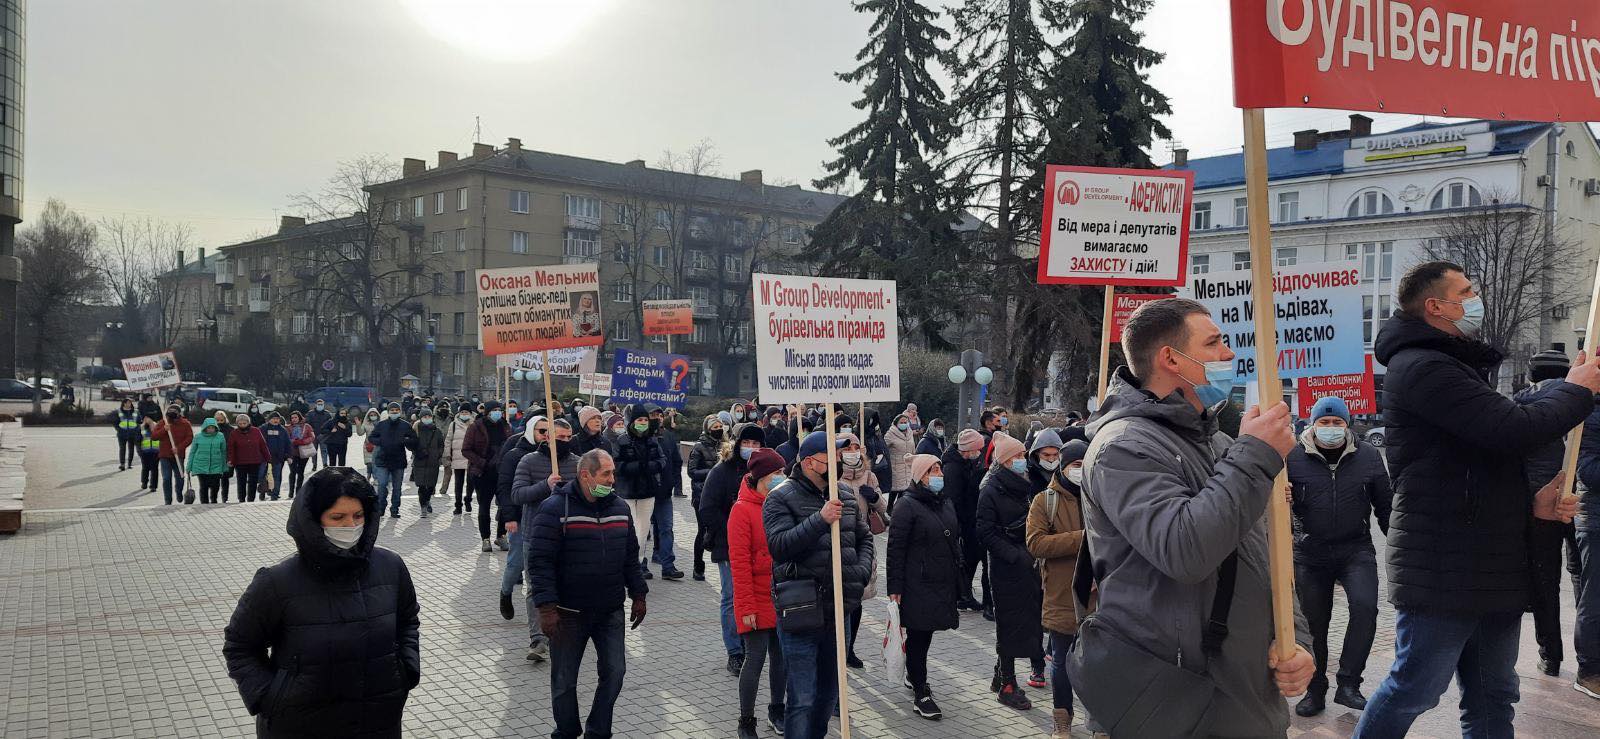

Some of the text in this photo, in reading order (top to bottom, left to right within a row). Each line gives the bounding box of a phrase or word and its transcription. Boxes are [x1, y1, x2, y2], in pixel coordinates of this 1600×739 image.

[1550, 19, 1600, 98] пір
[1084, 193, 1123, 201] DEVELOPMENT
[1129, 181, 1183, 213] АФЕРИСТИ!
[1058, 218, 1177, 238] Від мера і депутатів
[1084, 241, 1148, 253] вимагаємо
[1070, 257, 1158, 274] ЗАХИСТУ і дій!
[479, 270, 598, 291] Оксана Мельник
[1194, 278, 1252, 299] Мельни
[479, 287, 568, 313] успішна бізнес-леді
[760, 280, 770, 305] M
[774, 280, 809, 313] Group
[812, 282, 884, 315] Development
[481, 307, 571, 327] за кошти обманутих
[1221, 296, 1333, 323] на Мьдівах,
[496, 322, 567, 346] простих людей!
[769, 312, 885, 345] будівельна піраміда
[1236, 331, 1255, 347] ми
[1284, 324, 1335, 344] маємо
[522, 358, 580, 374] ШАХАЯМИ!
[626, 353, 657, 366] Влада
[784, 348, 874, 370] Міська влада надає
[1236, 346, 1322, 376] де ИТИ!!!
[616, 366, 665, 378] з людьми
[768, 371, 891, 393] численні дозволи шахраям
[1307, 376, 1325, 387] Ваші
[635, 379, 647, 388] чи
[1312, 386, 1360, 400] Нам потрібні
[611, 388, 686, 402] з аферистами?
[1345, 398, 1369, 411] ТИРИ!
